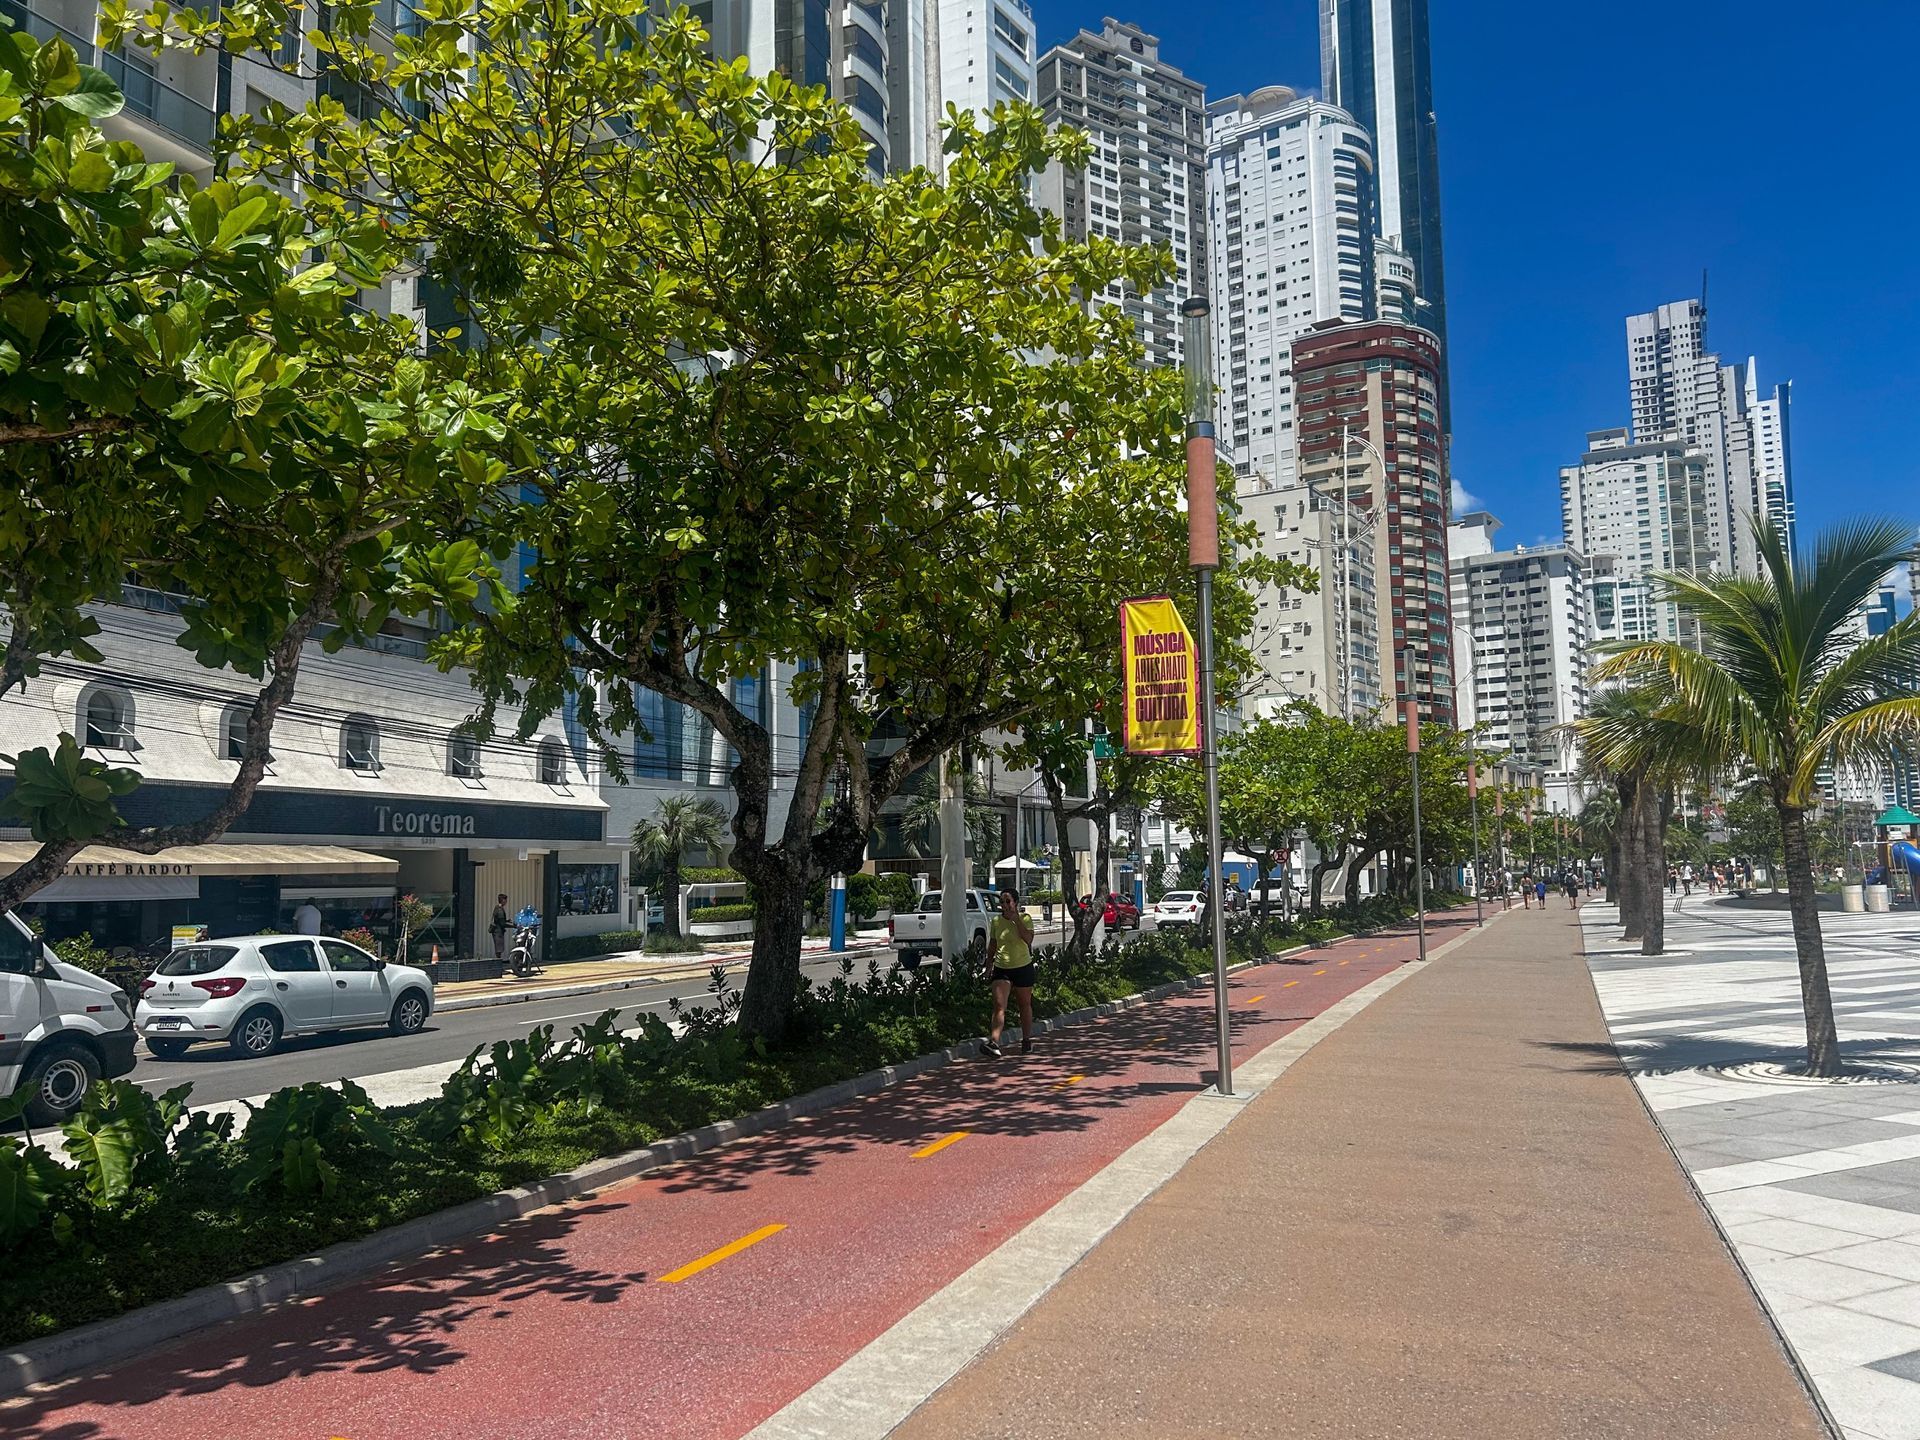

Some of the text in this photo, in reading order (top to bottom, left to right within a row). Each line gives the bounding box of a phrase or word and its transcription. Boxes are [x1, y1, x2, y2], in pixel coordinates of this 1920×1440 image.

[1134, 629, 1186, 656] MÚSICA
[1135, 655, 1187, 683] ARTESANATO
[1135, 682, 1187, 696] GASTRONOMIA
[1136, 695, 1188, 722] CULTURA
[374, 806, 475, 834] Teorema
[62, 862, 193, 875] CAFFÈ BARDOT
